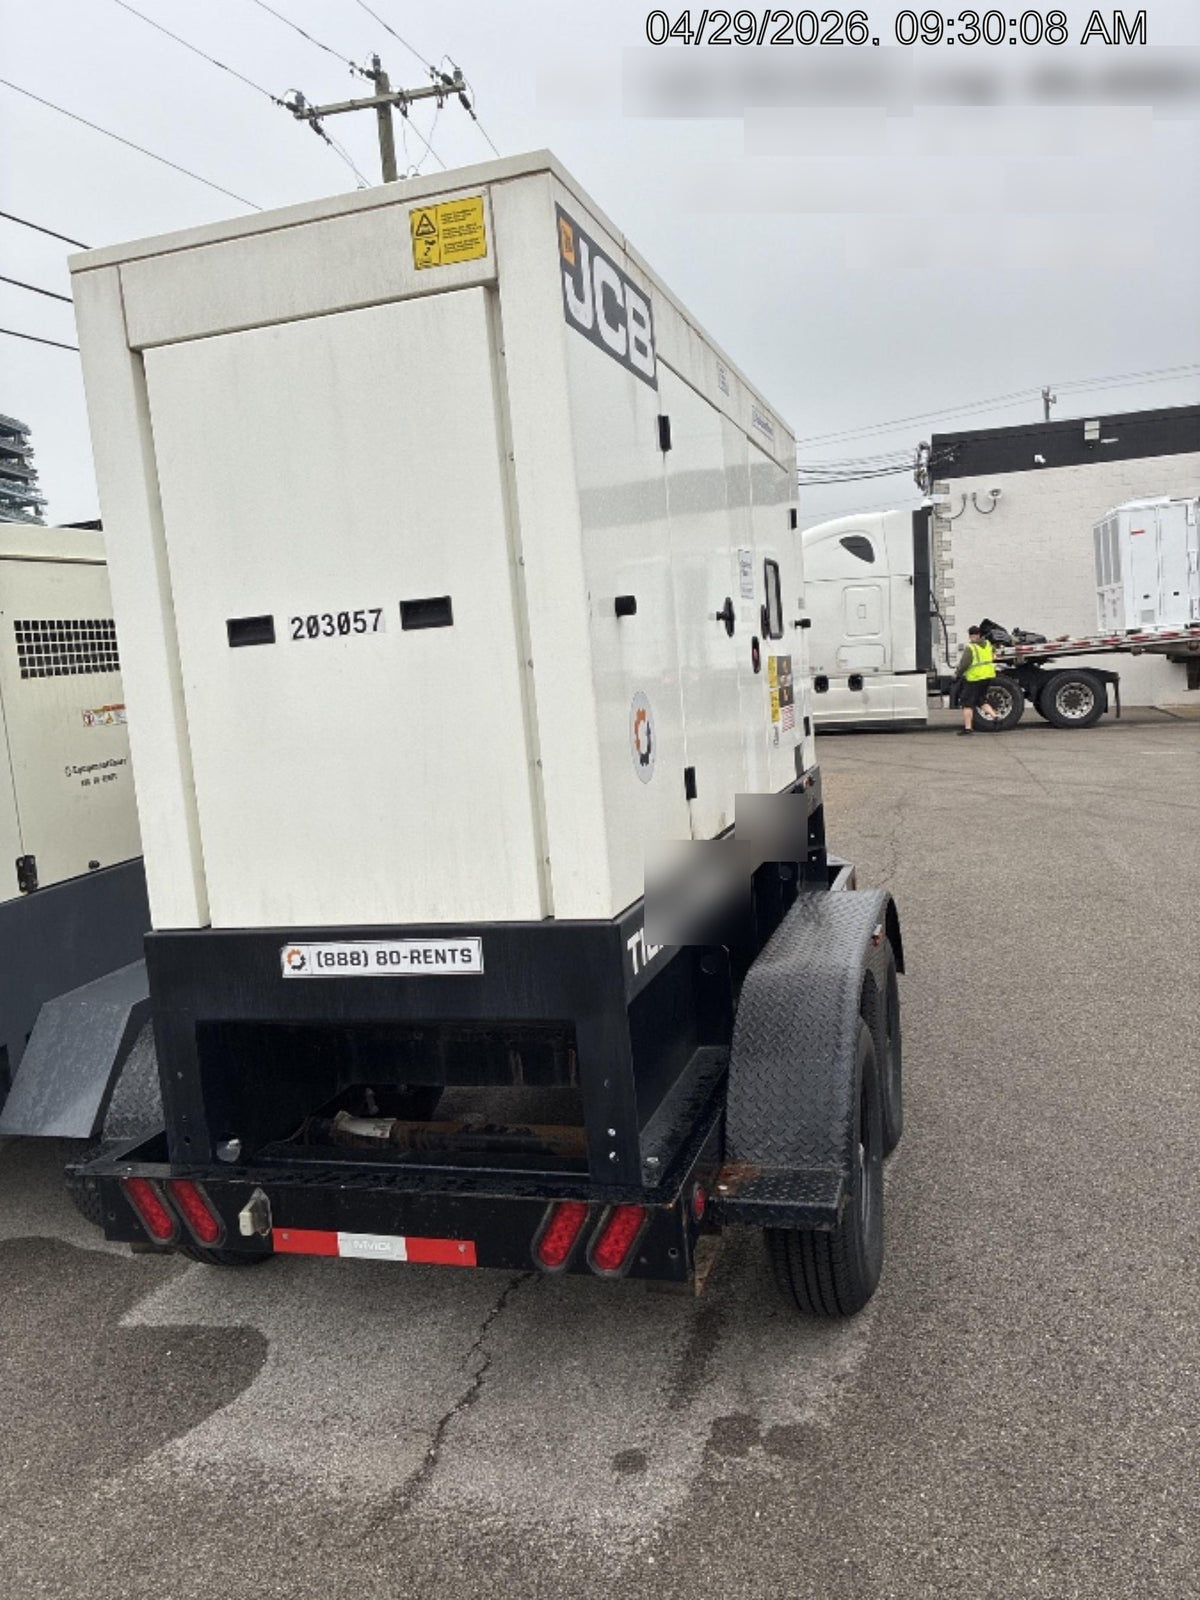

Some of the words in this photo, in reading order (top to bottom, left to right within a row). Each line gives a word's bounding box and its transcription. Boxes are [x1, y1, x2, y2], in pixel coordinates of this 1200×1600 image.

[564, 237, 655, 379] JCB
[290, 608, 383, 641] 203057
[317, 950, 369, 968] (888)
[376, 948, 473, 967] 80-RENTS
